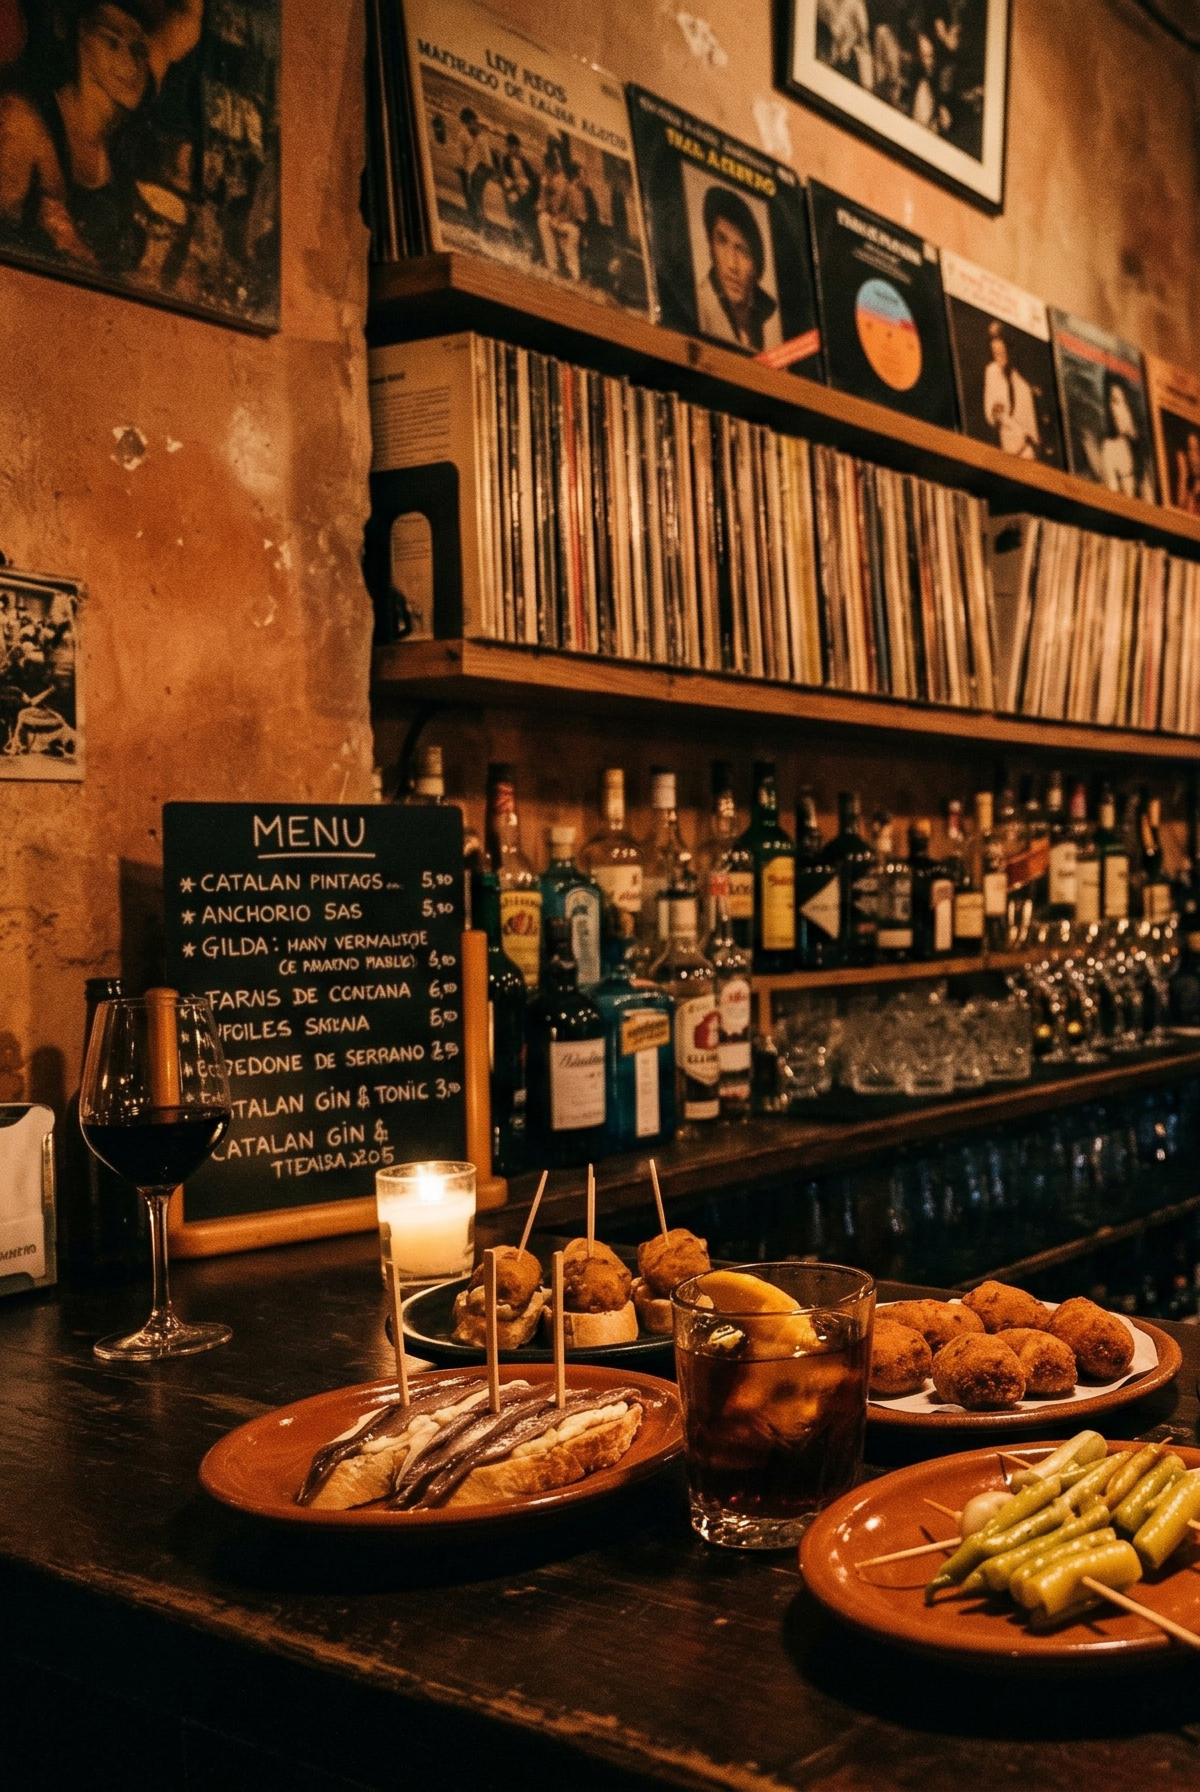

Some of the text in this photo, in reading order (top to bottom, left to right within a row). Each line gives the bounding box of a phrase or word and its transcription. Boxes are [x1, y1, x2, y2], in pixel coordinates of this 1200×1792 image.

[253, 814, 366, 848] MENU
[200, 873, 301, 893] CATALAN
[202, 904, 311, 925] ANCHORIO
[324, 902, 363, 921] SAS
[292, 987, 319, 1006] DE
[314, 1051, 337, 1071] DE
[345, 1044, 425, 1068] SERRANO
